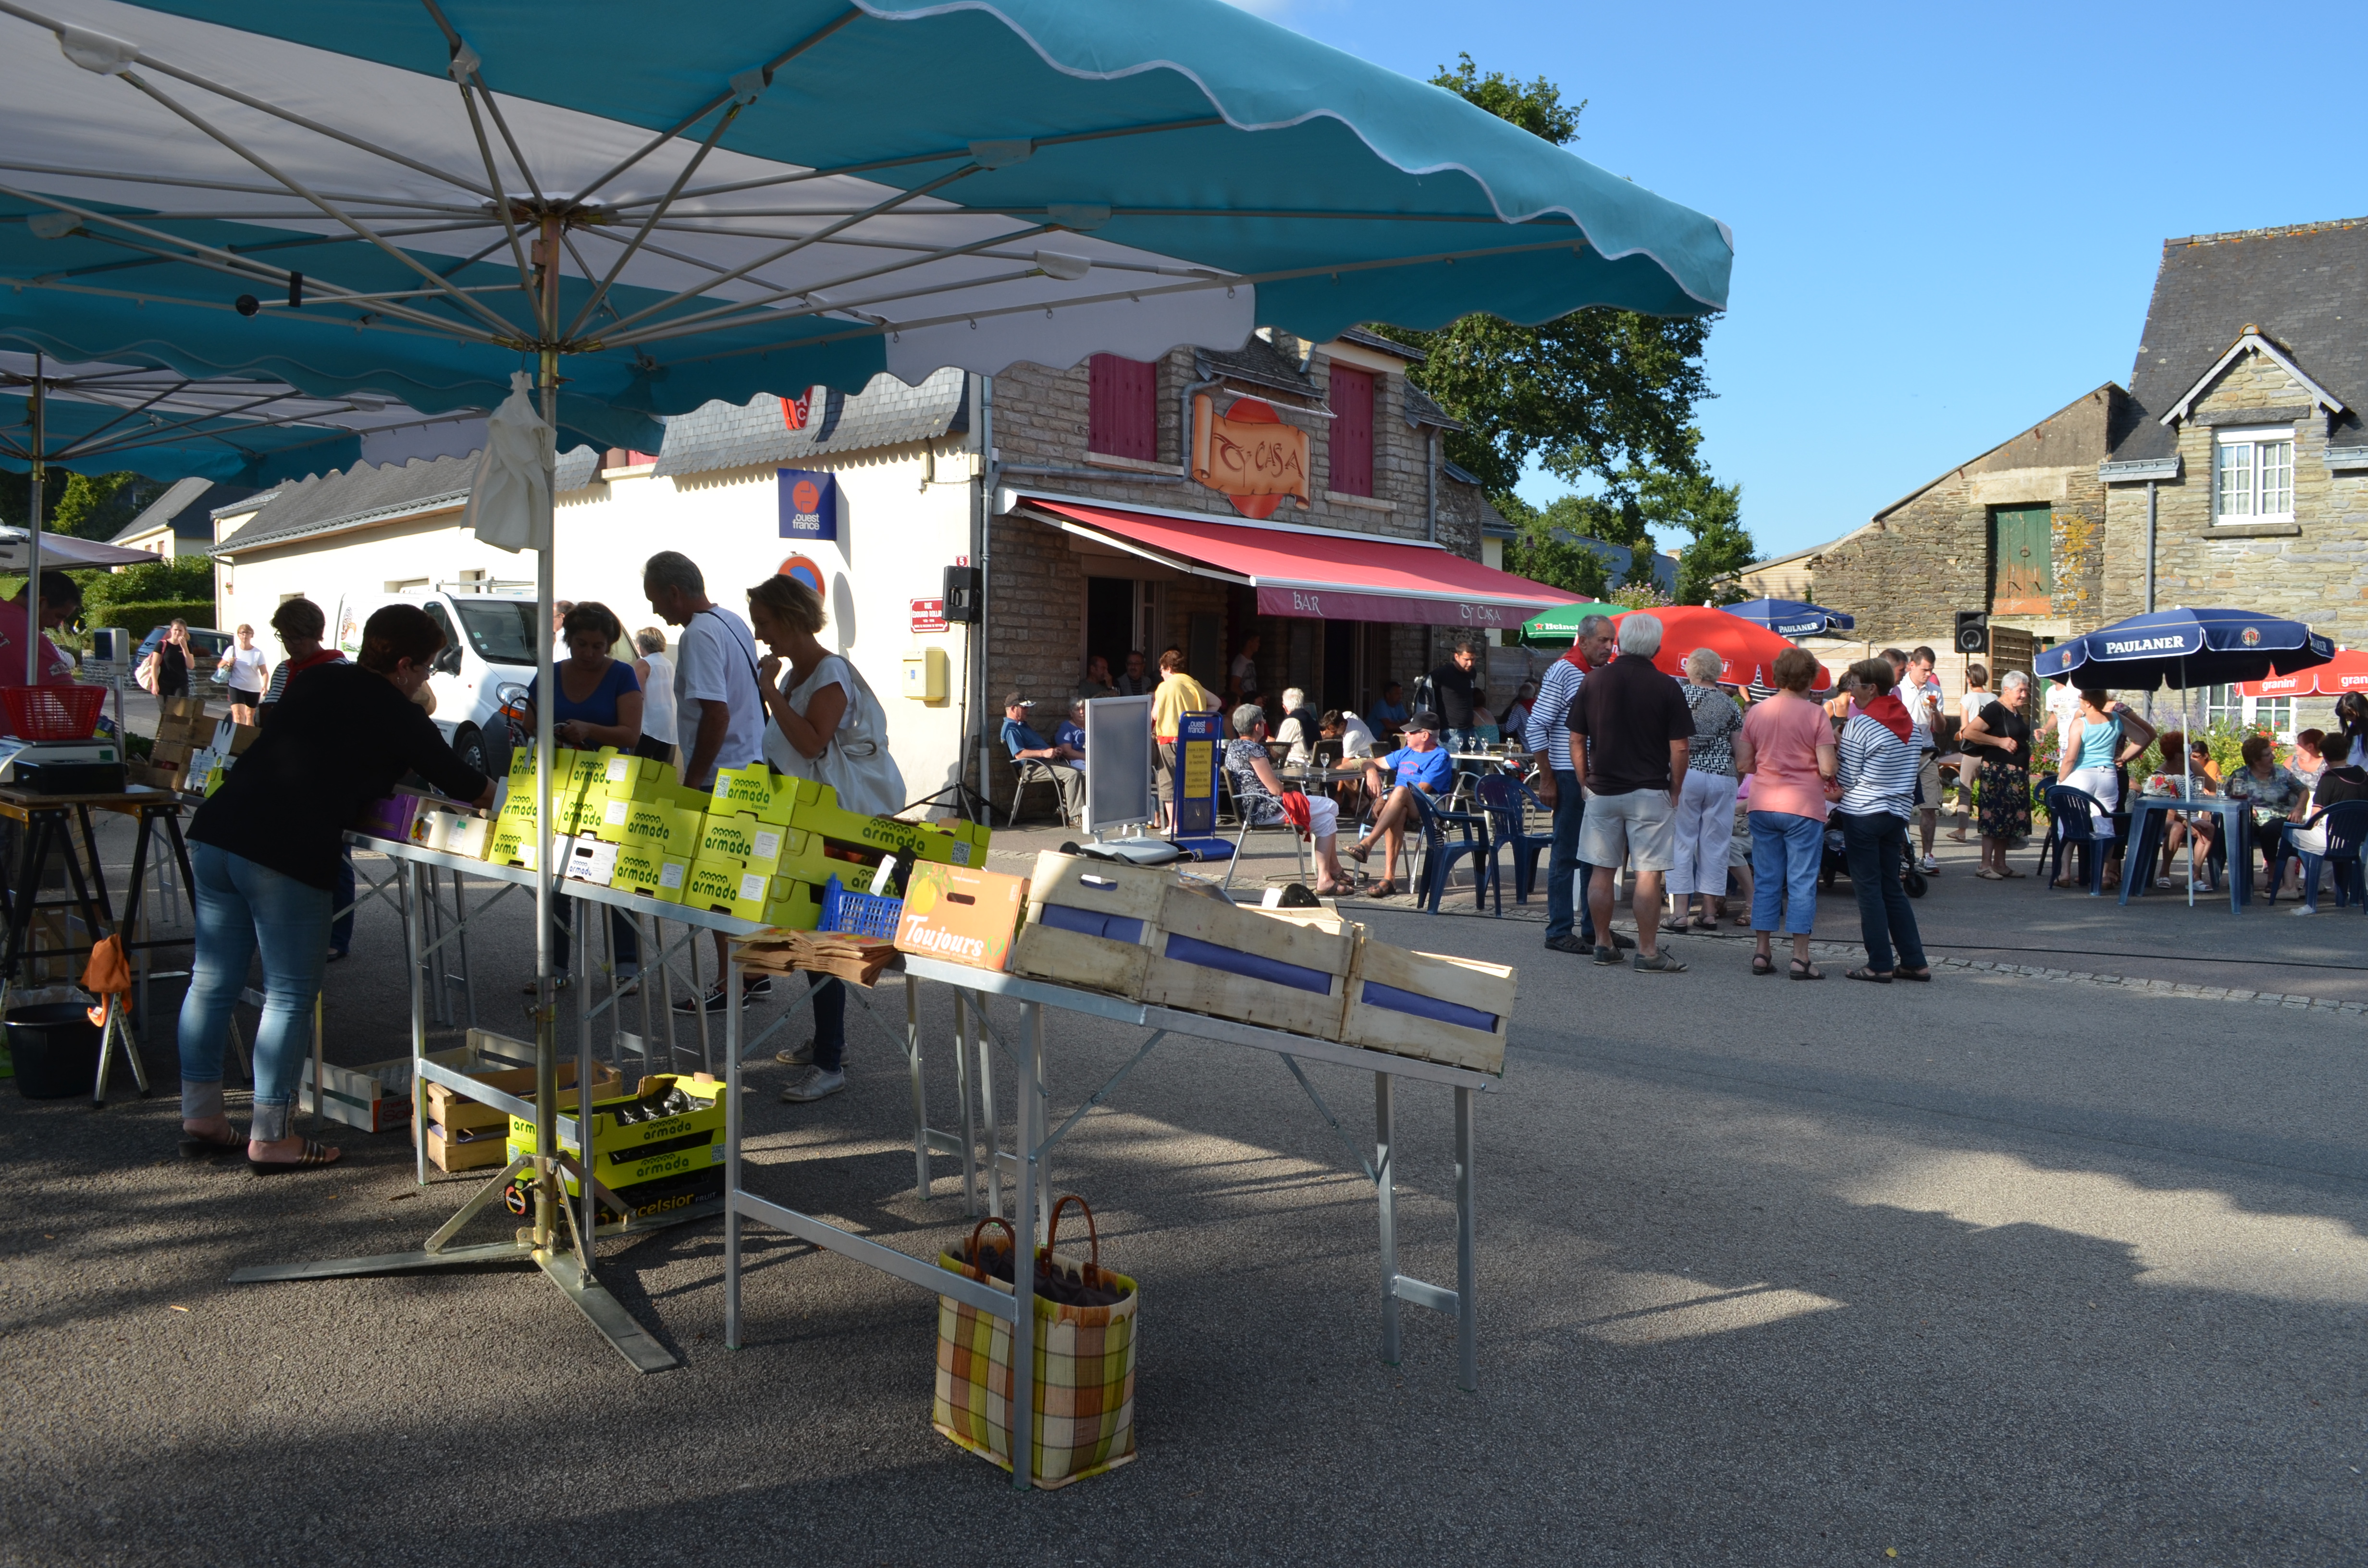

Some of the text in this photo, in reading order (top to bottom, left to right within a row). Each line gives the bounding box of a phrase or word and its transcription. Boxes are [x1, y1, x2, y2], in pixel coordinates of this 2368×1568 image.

[792, 520, 820, 530] france
[795, 513, 820, 522] ouest
[959, 557, 965, 566] 5
[1293, 591, 1323, 616] BAR
[1778, 623, 1818, 633] PAULANER
[2105, 636, 2184, 654] PAULANER
[2262, 678, 2296, 692] granini
[2341, 676, 2368, 687] gran
[512, 764, 537, 775] arma
[728, 788, 770, 804] armada
[564, 810, 601, 826] armada
[628, 822, 669, 840] armada
[705, 837, 751, 856] armada
[863, 827, 925, 852] armada
[494, 842, 517, 855] arma
[617, 866, 659, 885] armada
[692, 881, 737, 901] armada
[905, 915, 984, 957] Toujours
[514, 1121, 535, 1134] arm
[644, 1120, 691, 1140] armada
[637, 1156, 689, 1177] armada
[506, 1196, 526, 1207] excelsior
[634, 1191, 716, 1218] celsior FRUIT
